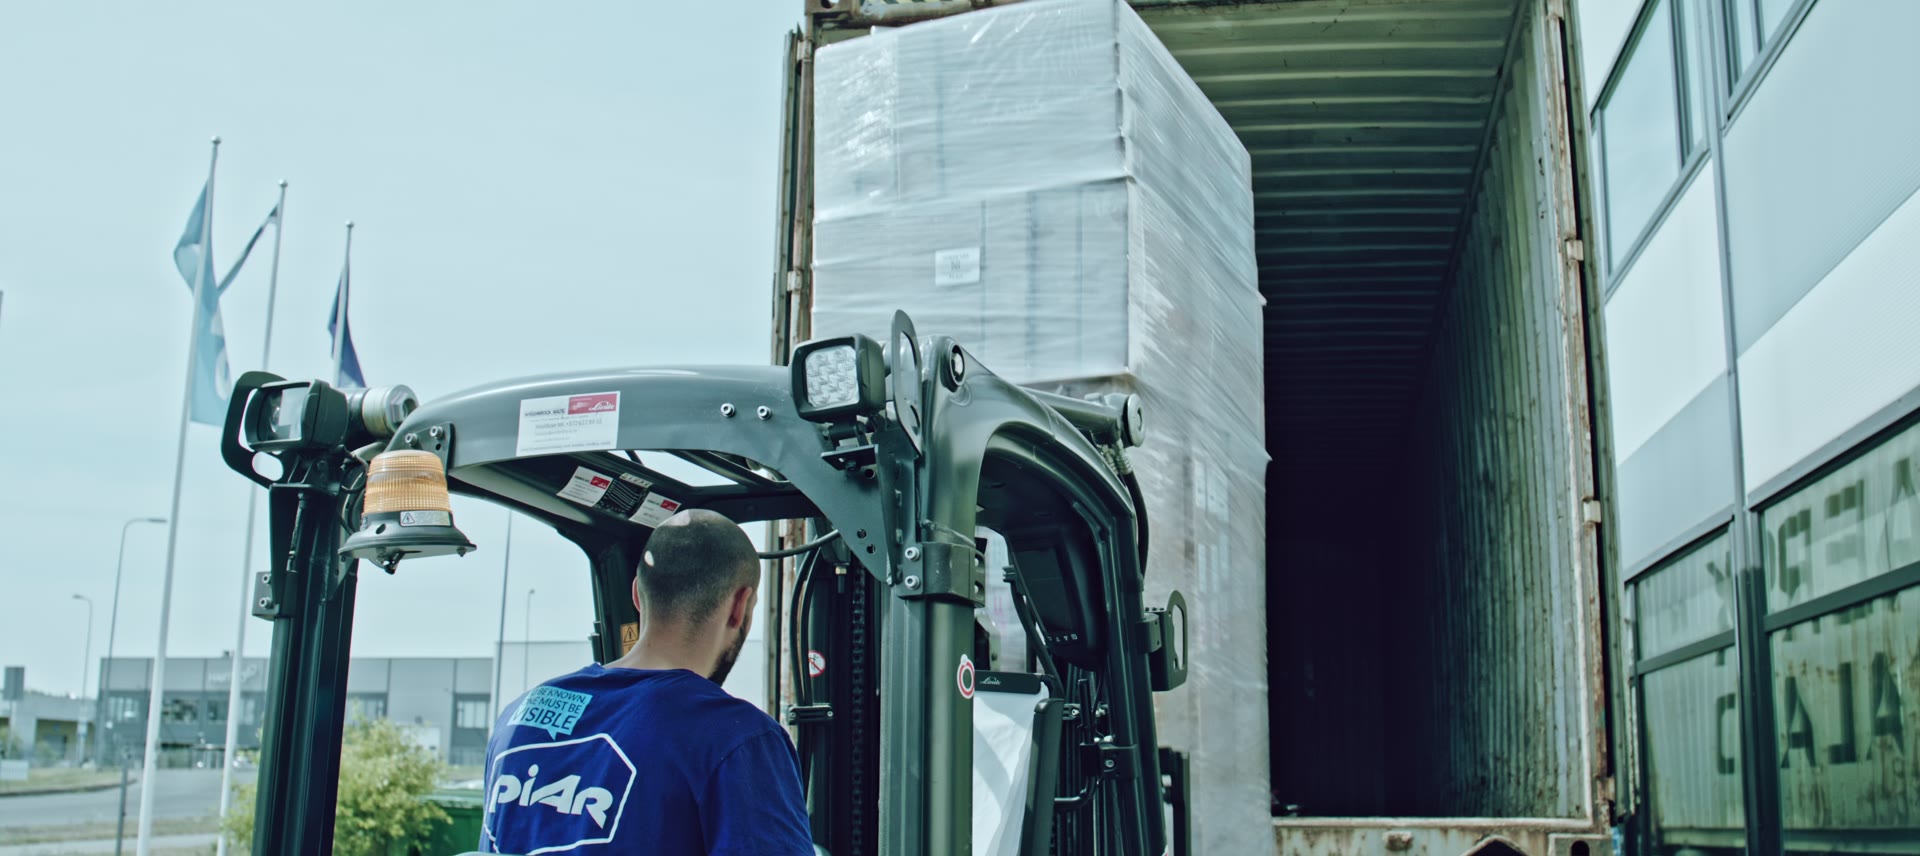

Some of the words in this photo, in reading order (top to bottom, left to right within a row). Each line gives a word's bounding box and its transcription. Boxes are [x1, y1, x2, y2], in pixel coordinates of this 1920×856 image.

[588, 400, 615, 411] Linde
[980, 676, 1001, 685] Linde
[538, 687, 548, 696] BE
[547, 688, 586, 704] KNOWN.
[539, 697, 568, 711] MUST
[568, 703, 583, 714] BE
